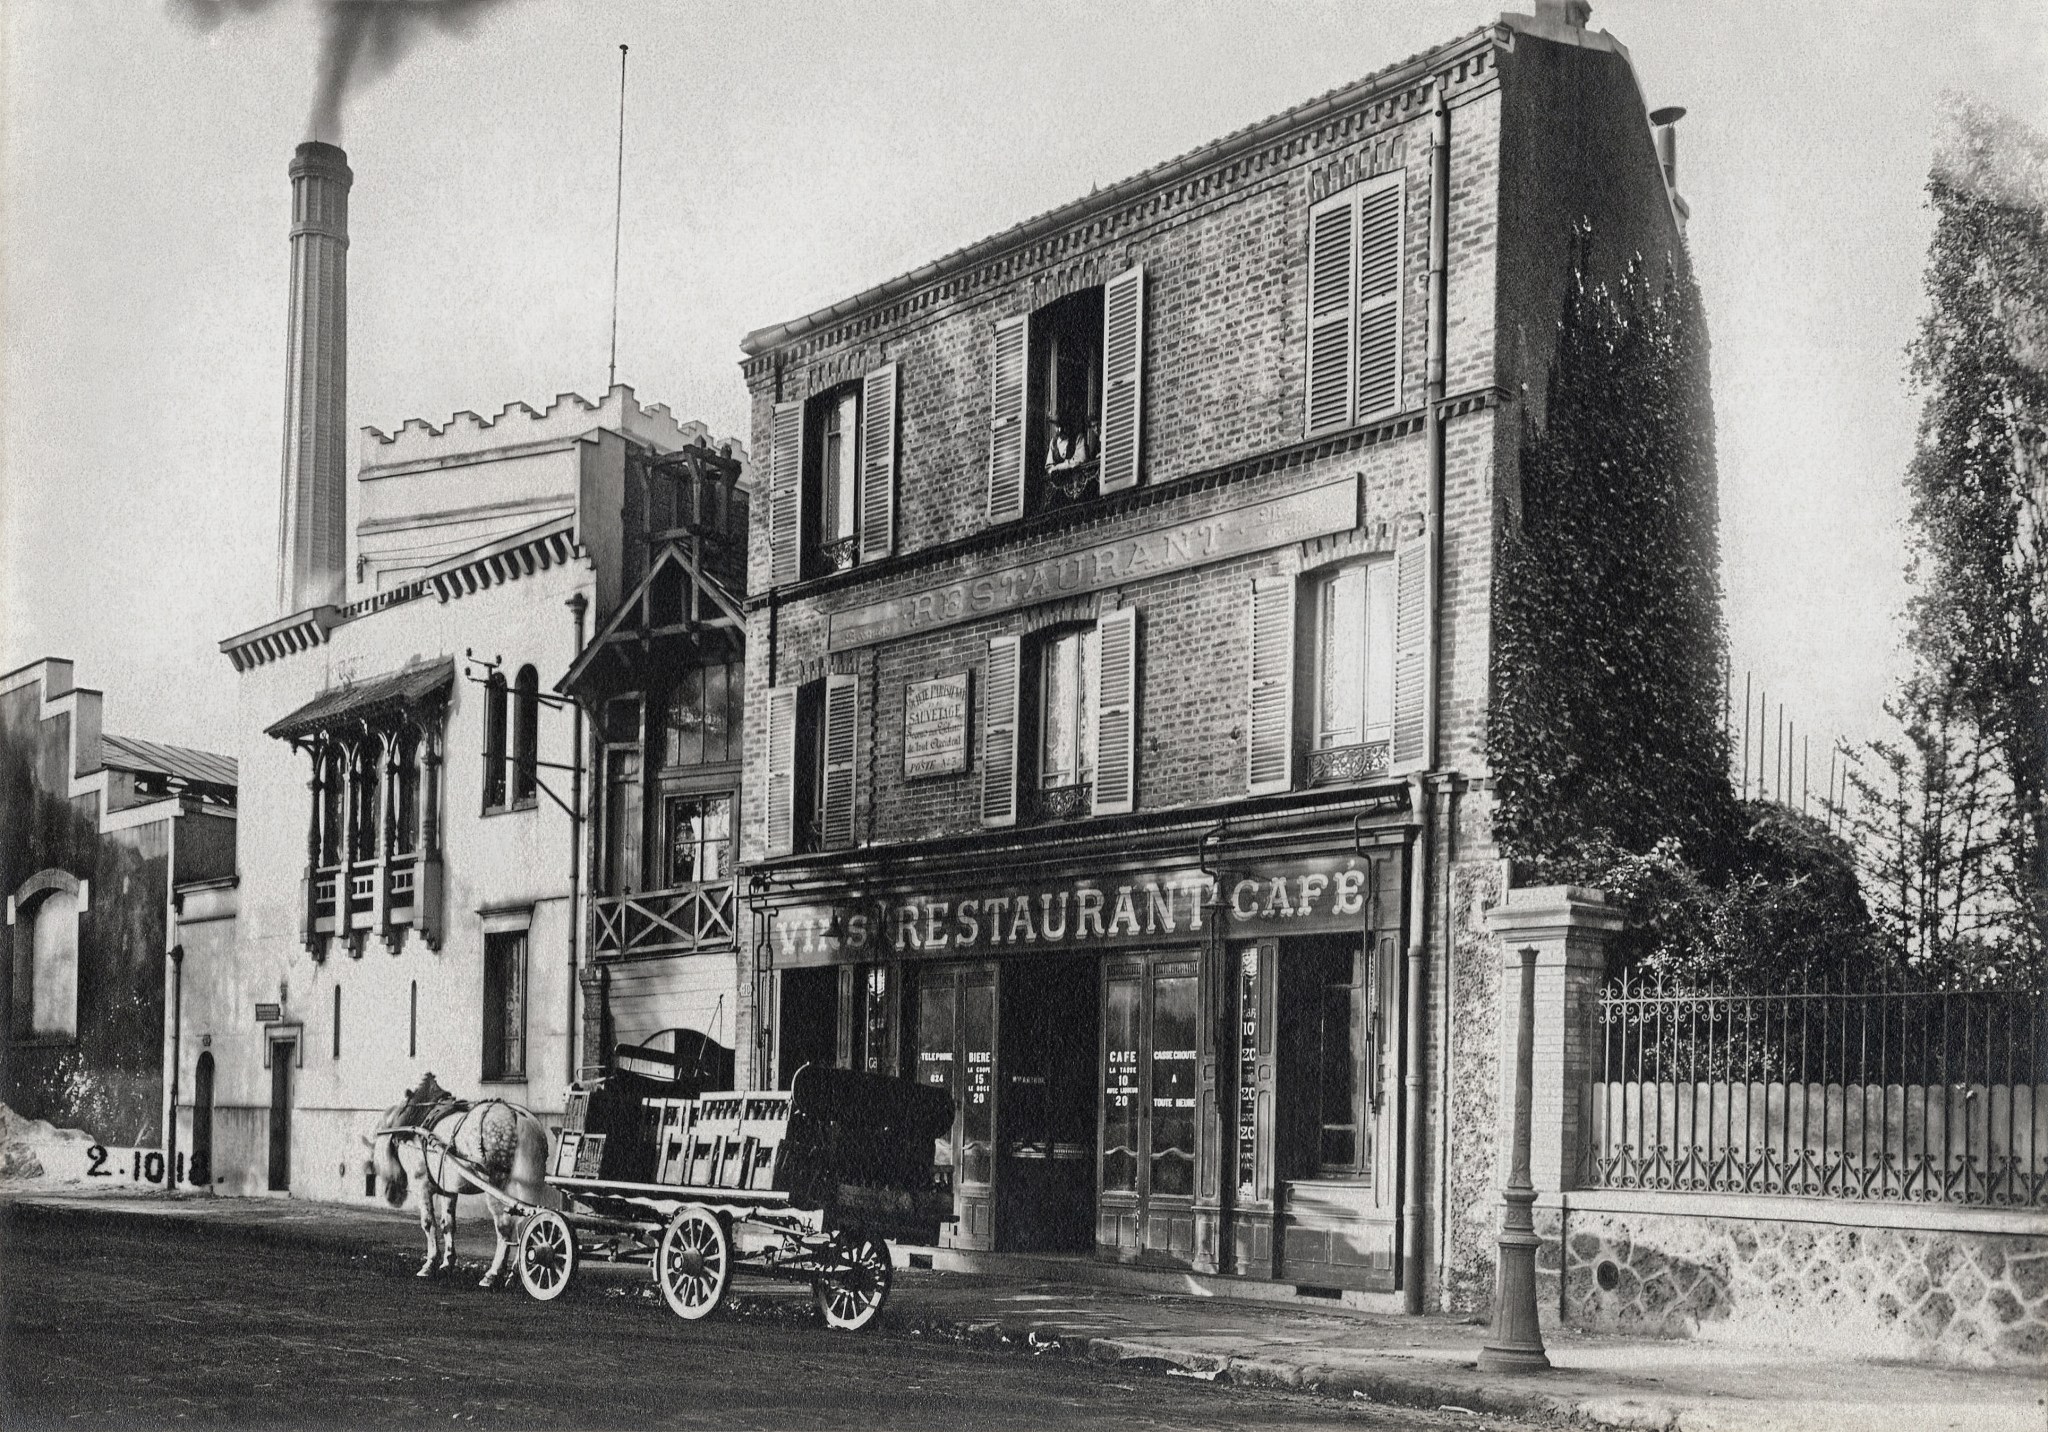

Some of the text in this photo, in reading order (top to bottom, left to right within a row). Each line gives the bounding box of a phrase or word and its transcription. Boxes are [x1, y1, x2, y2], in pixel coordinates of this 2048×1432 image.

[911, 523, 1224, 627] RESTAURANT
[909, 704, 961, 724] SAUVETAGE
[895, 876, 1214, 950] RESTAURANT
[1231, 859, 1365, 921] CAFÉ
[968, 1052, 990, 1063] BIERE
[1109, 1051, 1136, 1062] CAFE
[975, 1074, 984, 1084] 15
[1118, 1074, 1128, 1086] 10
[1171, 1074, 1177, 1083] A
[973, 1093, 984, 1103] 20
[1115, 1095, 1128, 1107] 20
[1153, 1098, 1173, 1107] TOUTE
